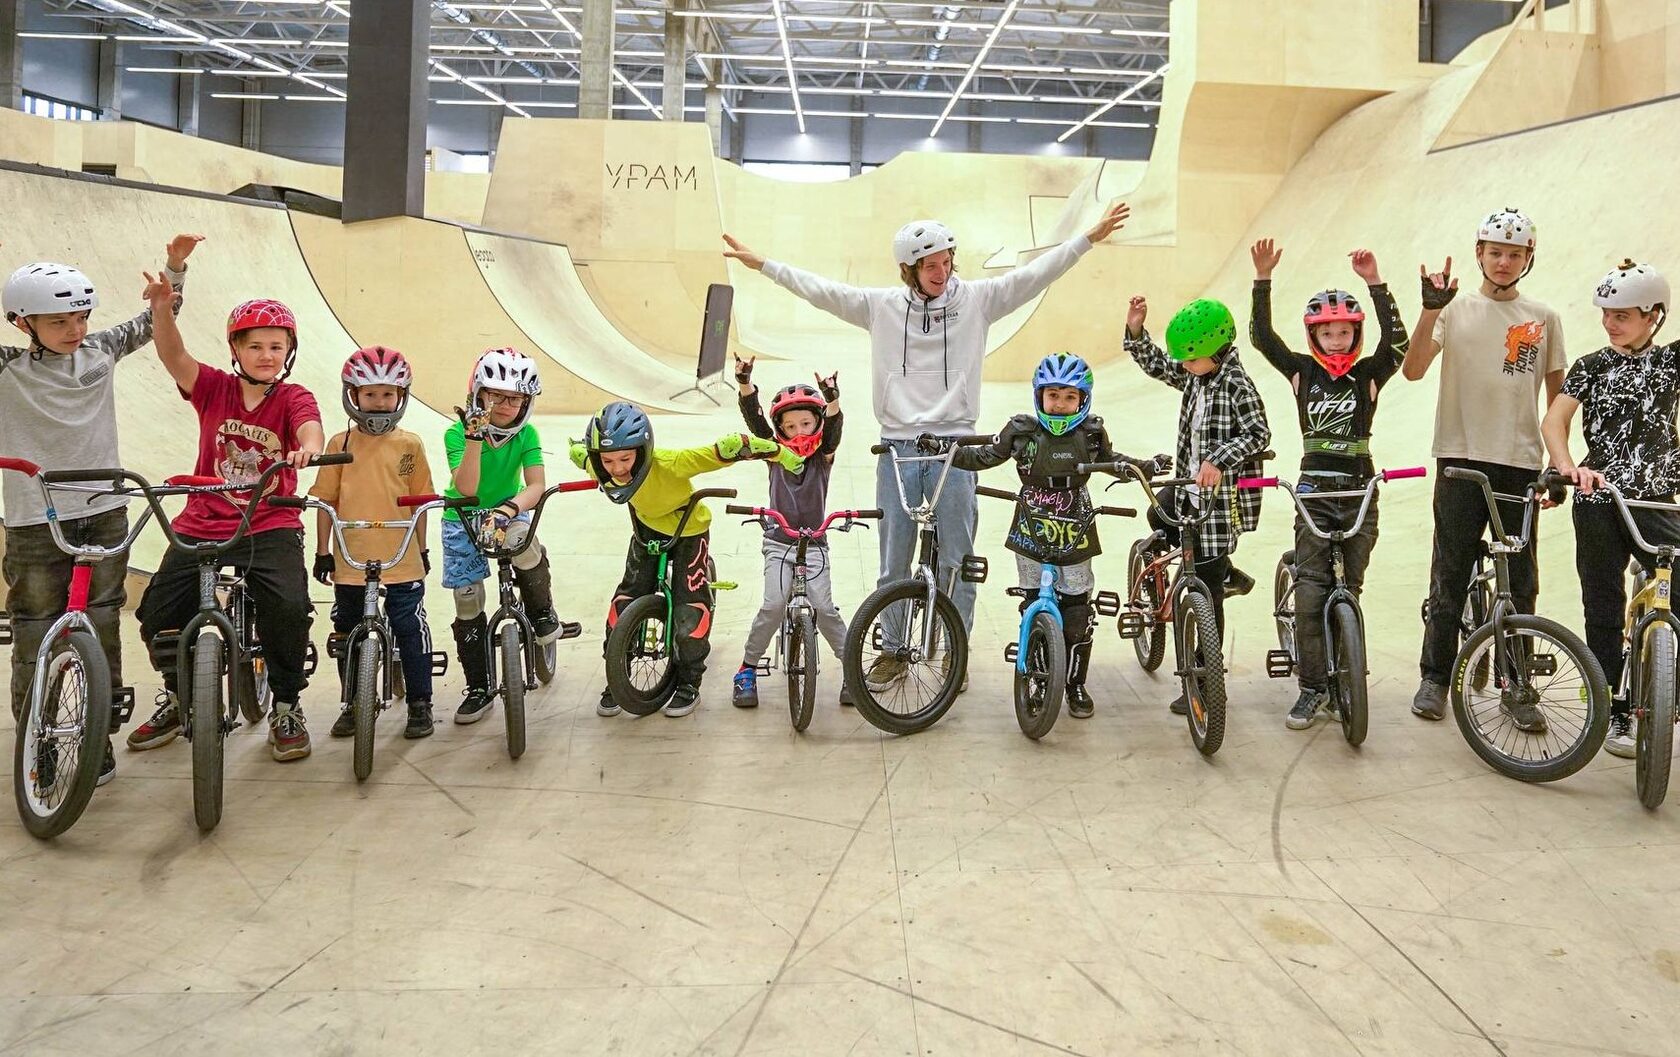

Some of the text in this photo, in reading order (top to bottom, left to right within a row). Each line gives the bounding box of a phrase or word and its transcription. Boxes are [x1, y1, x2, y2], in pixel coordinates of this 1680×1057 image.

[1515, 340, 1531, 374] TOUCH
[1502, 359, 1515, 376] ME
[1307, 399, 1357, 415] UFO
